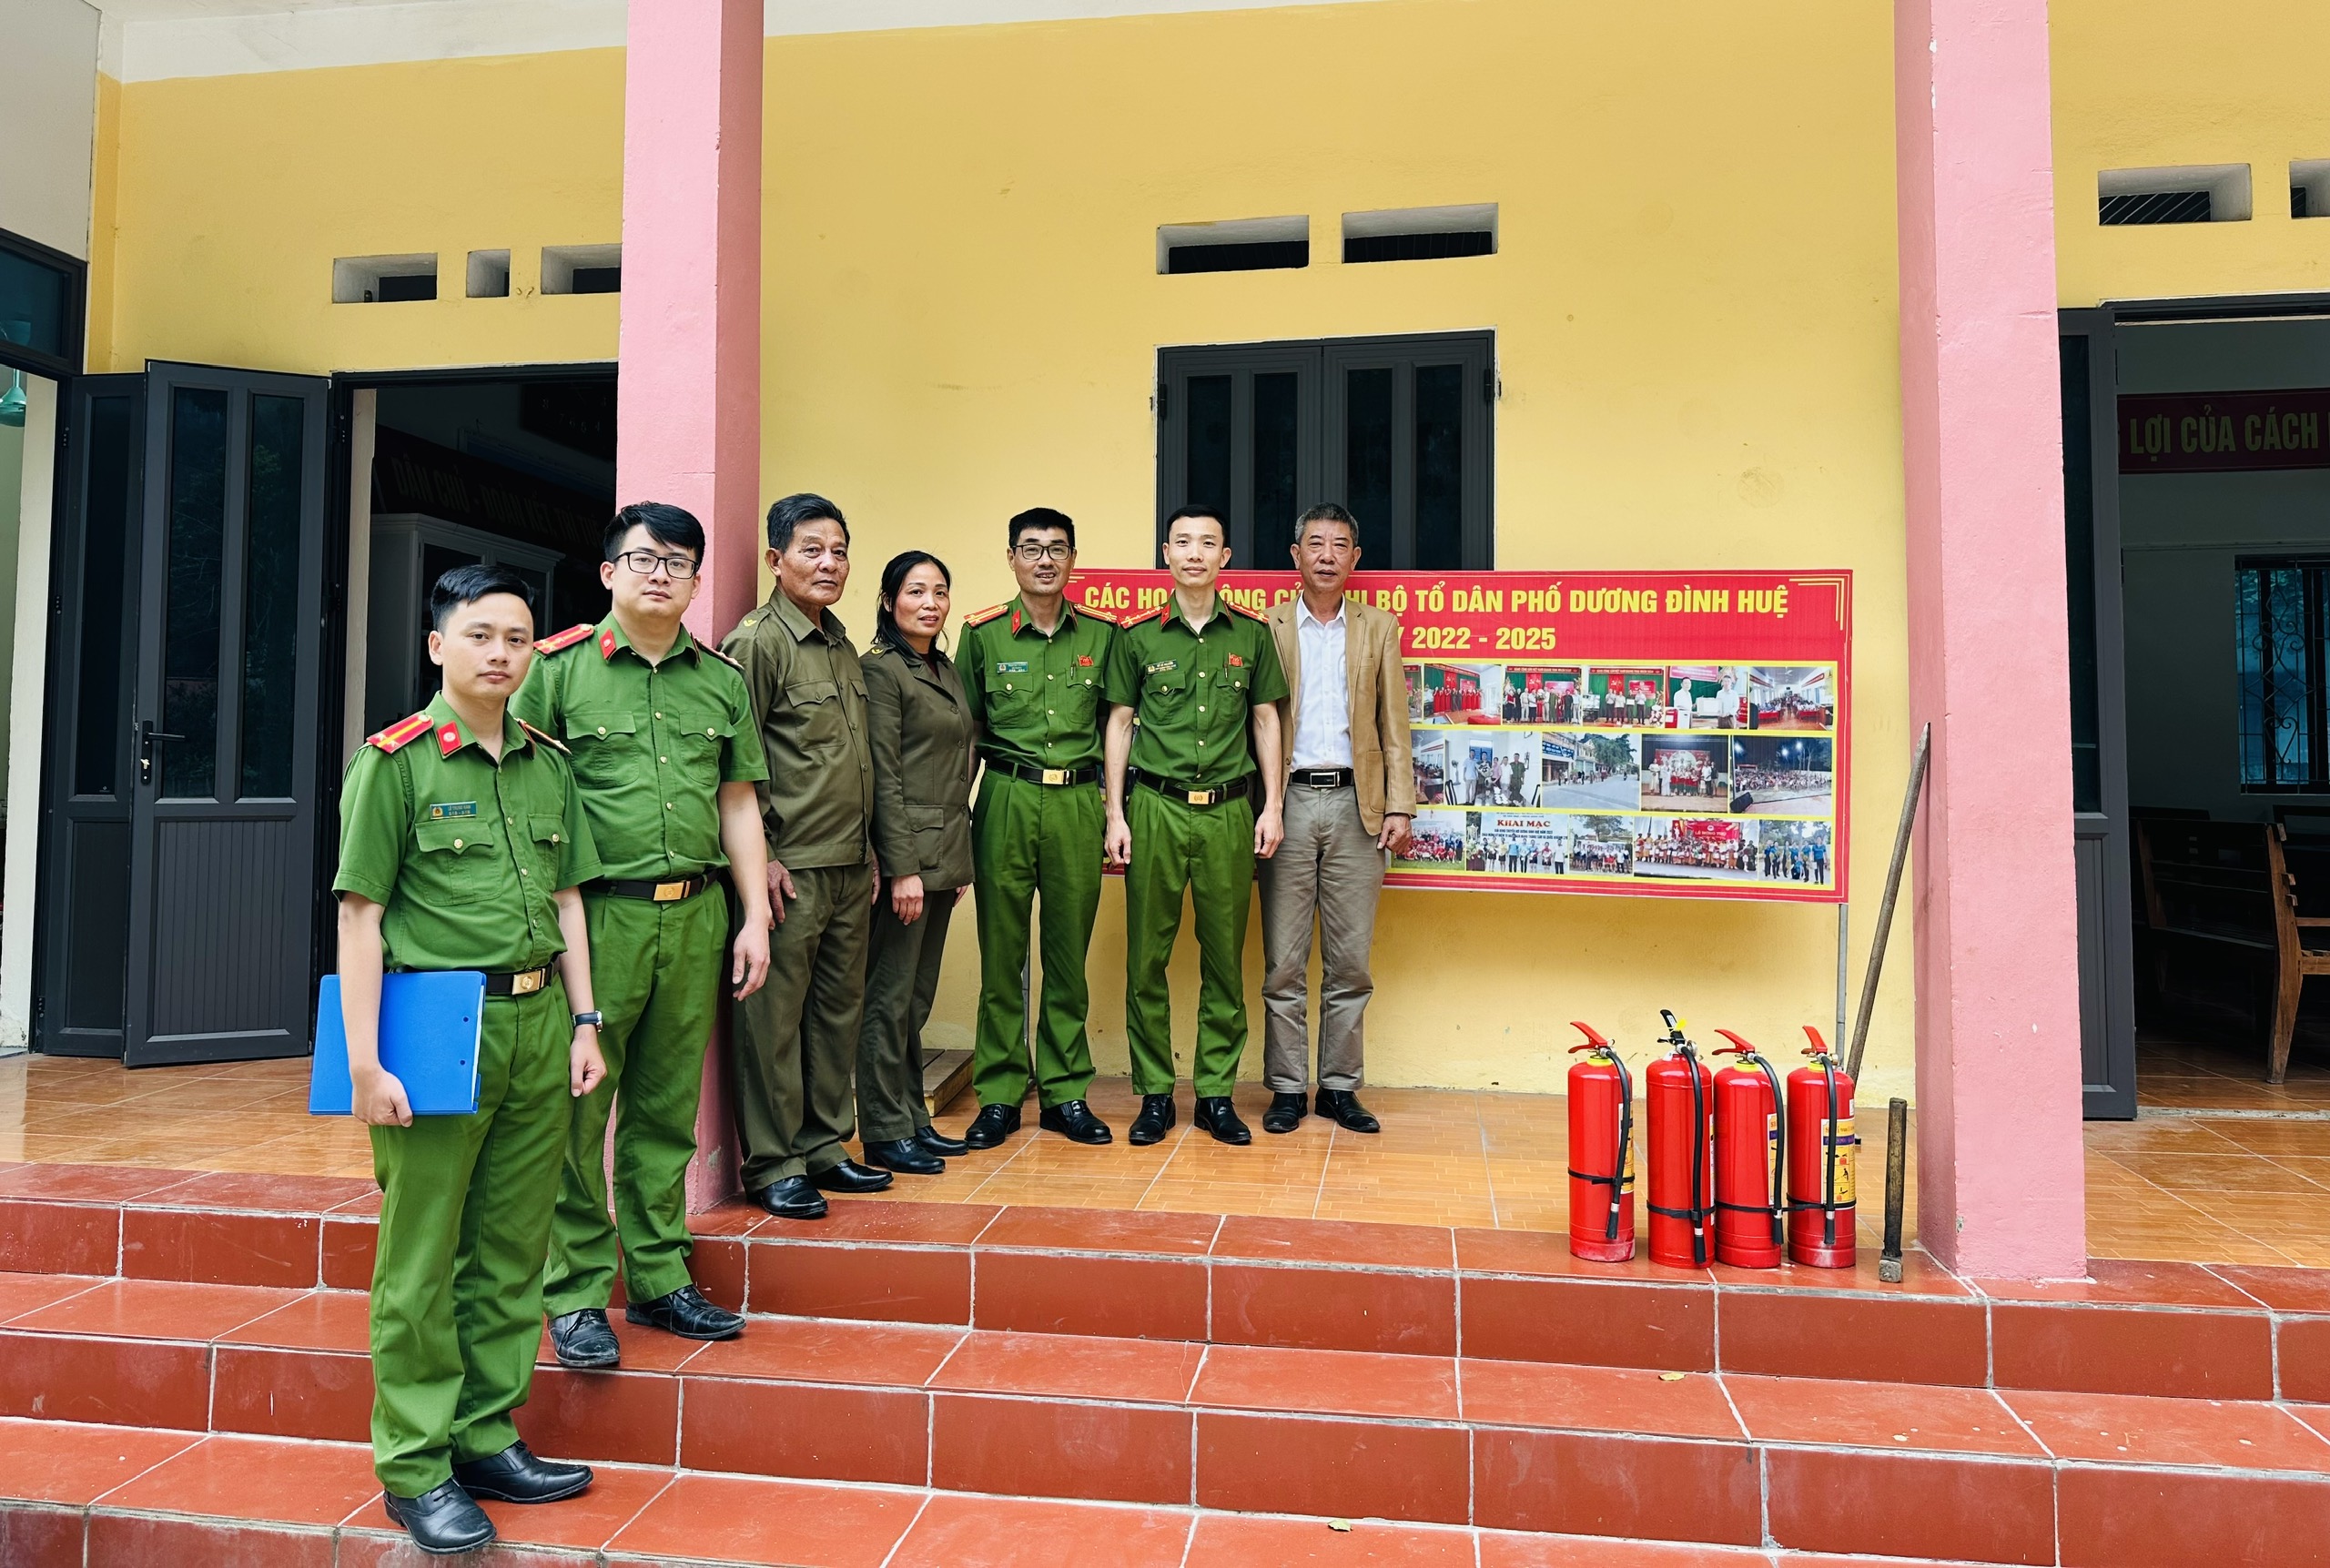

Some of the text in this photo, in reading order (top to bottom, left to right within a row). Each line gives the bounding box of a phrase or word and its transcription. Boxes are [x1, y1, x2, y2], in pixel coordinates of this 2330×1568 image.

[2130, 414, 2171, 461] LỢI
[2181, 404, 2236, 453] CỦA
[2244, 406, 2319, 451] CÁCH
[1085, 582, 1130, 609] CÁC
[1139, 588, 1175, 610] HO
[1345, 591, 1367, 606] HI
[1376, 585, 1407, 616] BỘ
[1415, 581, 1445, 612] TỔ
[1453, 585, 1503, 612] DÂN
[1512, 582, 1563, 612] PHỐ
[1570, 587, 1657, 613] DƯƠNG
[1666, 584, 1728, 613] ĐÌNH
[1737, 585, 1788, 618] HUỆ
[1412, 626, 1471, 649] 2022
[1495, 627, 1556, 650] 2025
[1526, 821, 1551, 829] MẠC
